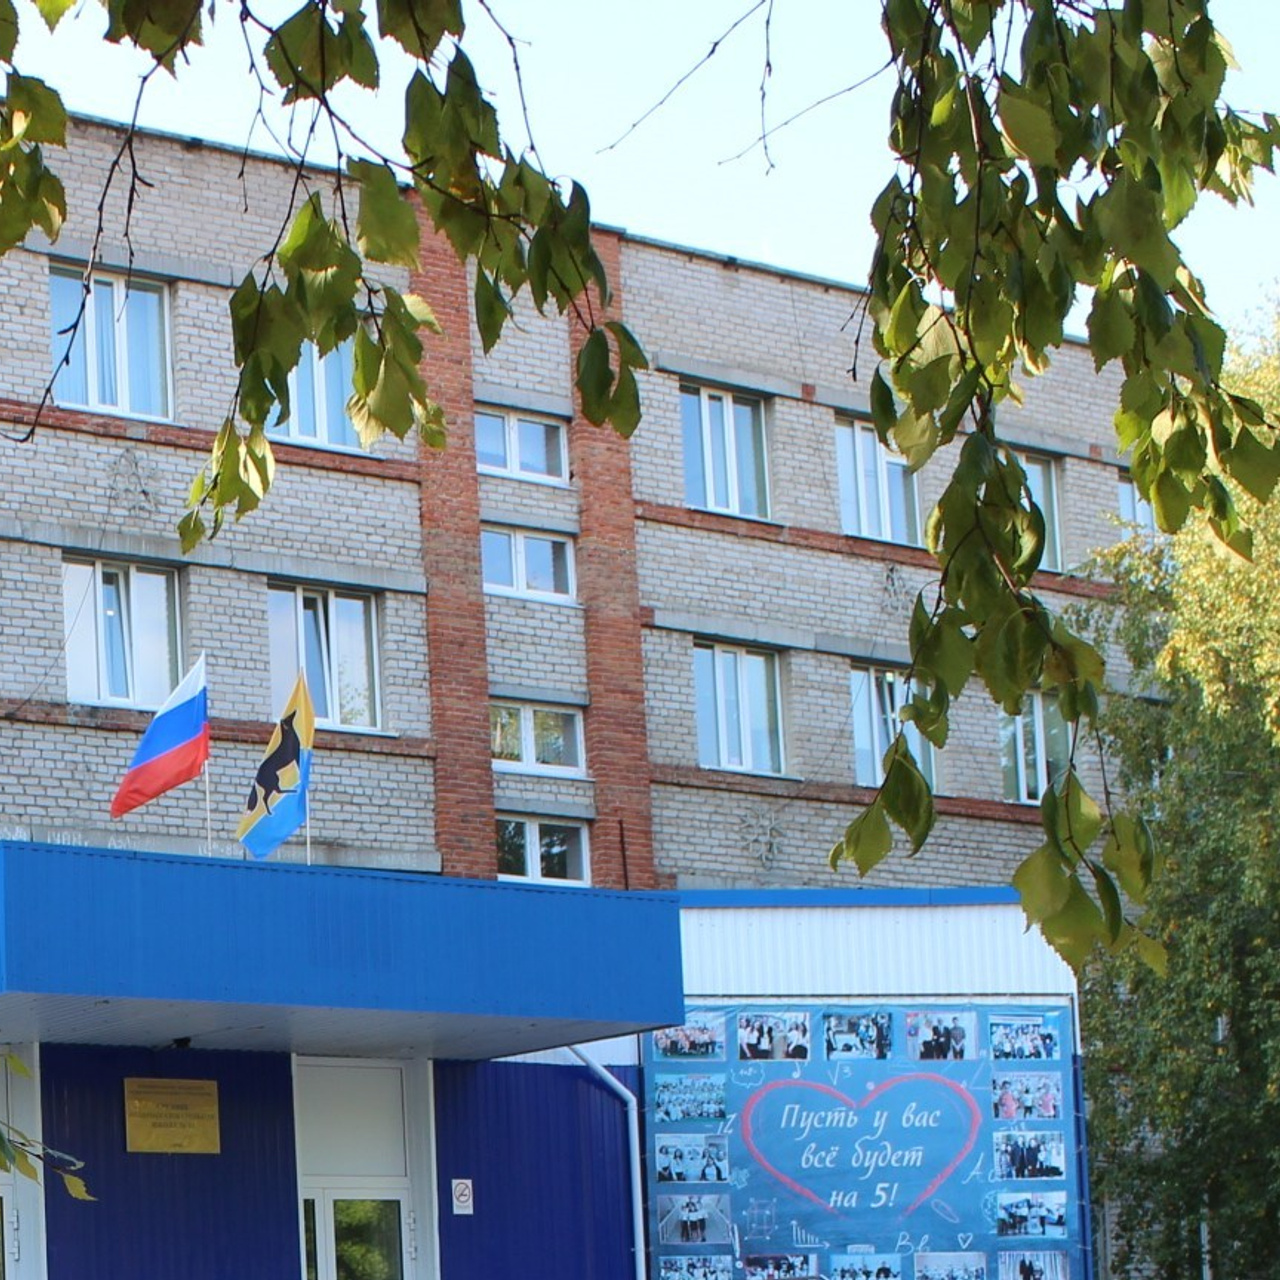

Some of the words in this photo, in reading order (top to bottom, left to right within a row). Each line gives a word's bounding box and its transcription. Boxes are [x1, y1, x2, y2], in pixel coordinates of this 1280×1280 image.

[781, 1104, 858, 1141] Пусть
[869, 1110, 888, 1140] у
[901, 1102, 941, 1128] вас
[801, 1143, 839, 1168] всё
[851, 1136, 924, 1180] будет
[829, 1189, 859, 1208] на
[870, 1182, 899, 1209] 5!
